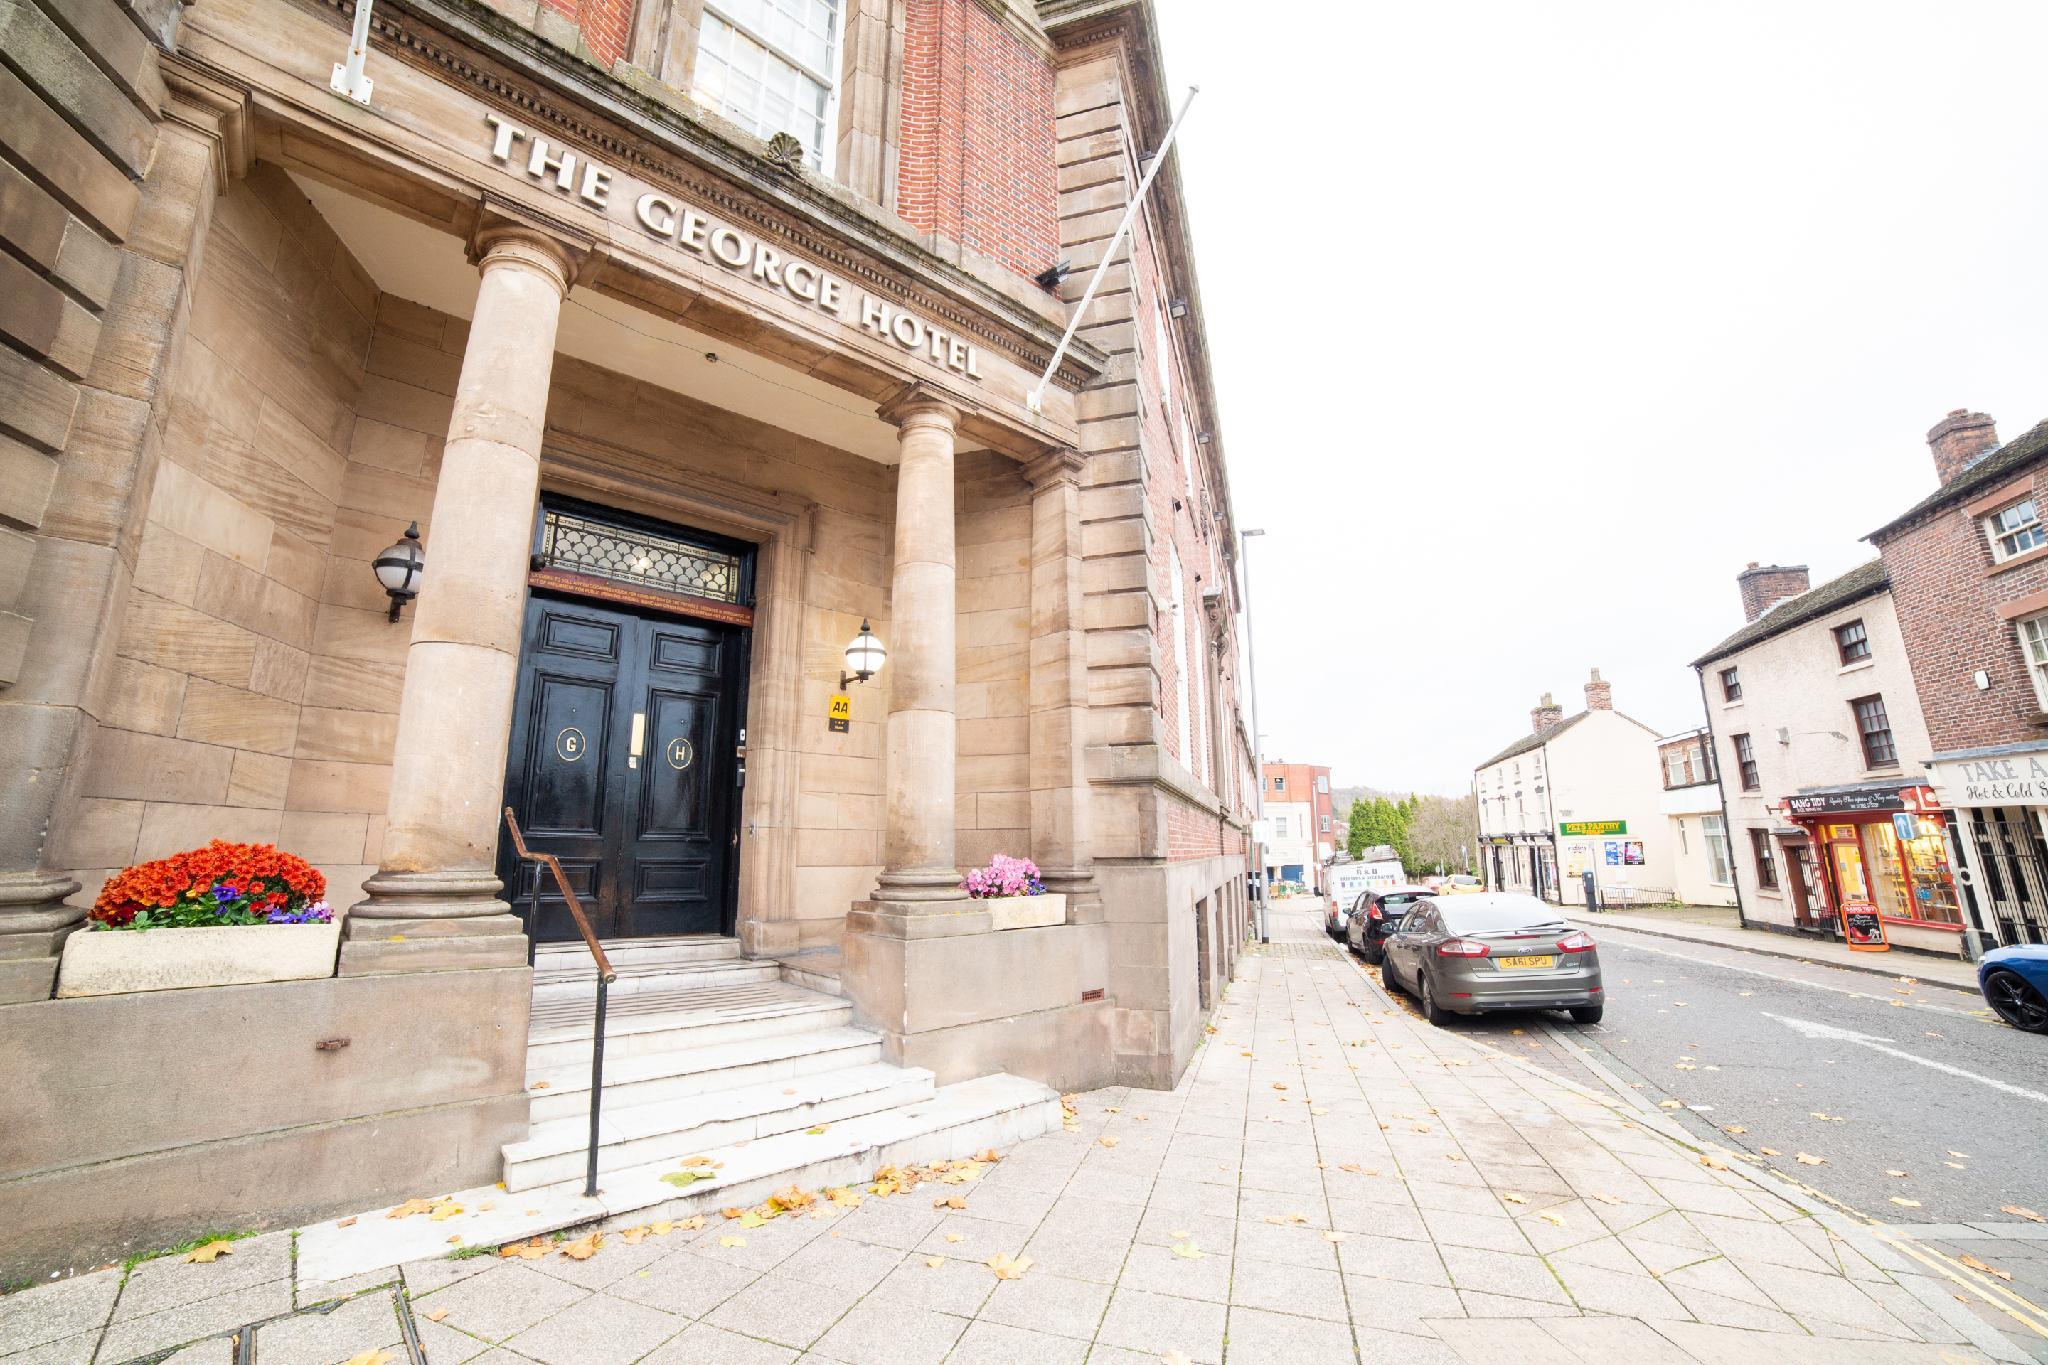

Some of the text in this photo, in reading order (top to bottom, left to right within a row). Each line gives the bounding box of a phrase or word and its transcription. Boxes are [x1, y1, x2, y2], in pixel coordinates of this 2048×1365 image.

[484, 113, 984, 380] THE GEORGE HOTEL
[832, 702, 848, 714] AA
[566, 737, 577, 752] G
[675, 746, 685, 760] H
[1958, 760, 2018, 782] TAKE
[1966, 784, 1990, 800] Hot
[1992, 783, 2005, 799] &
[2006, 782, 2035, 799] Cold
[1791, 797, 1826, 809] BANG TIDY
[1587, 821, 1620, 831] PANTRY
